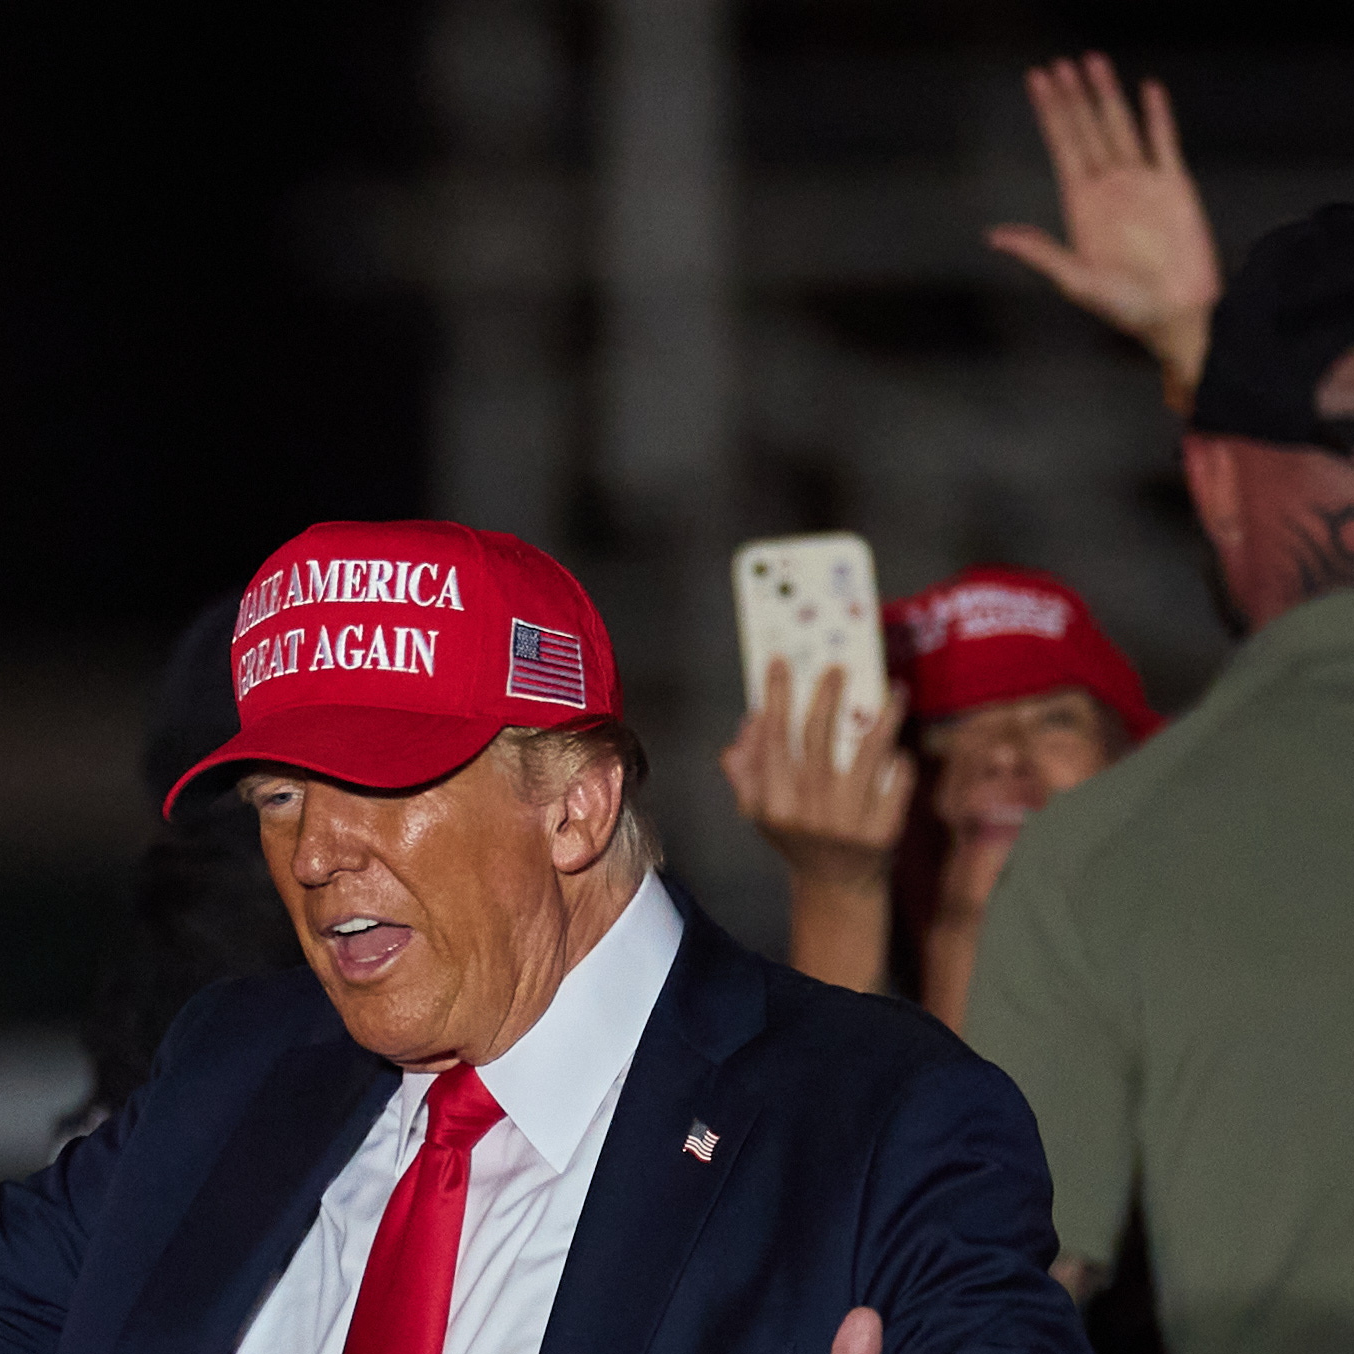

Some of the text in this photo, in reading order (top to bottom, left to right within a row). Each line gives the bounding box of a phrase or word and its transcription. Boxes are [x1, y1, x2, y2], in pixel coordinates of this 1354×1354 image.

[283, 560, 465, 612] AMERICA
[238, 623, 440, 702] GREAT AGAIN
